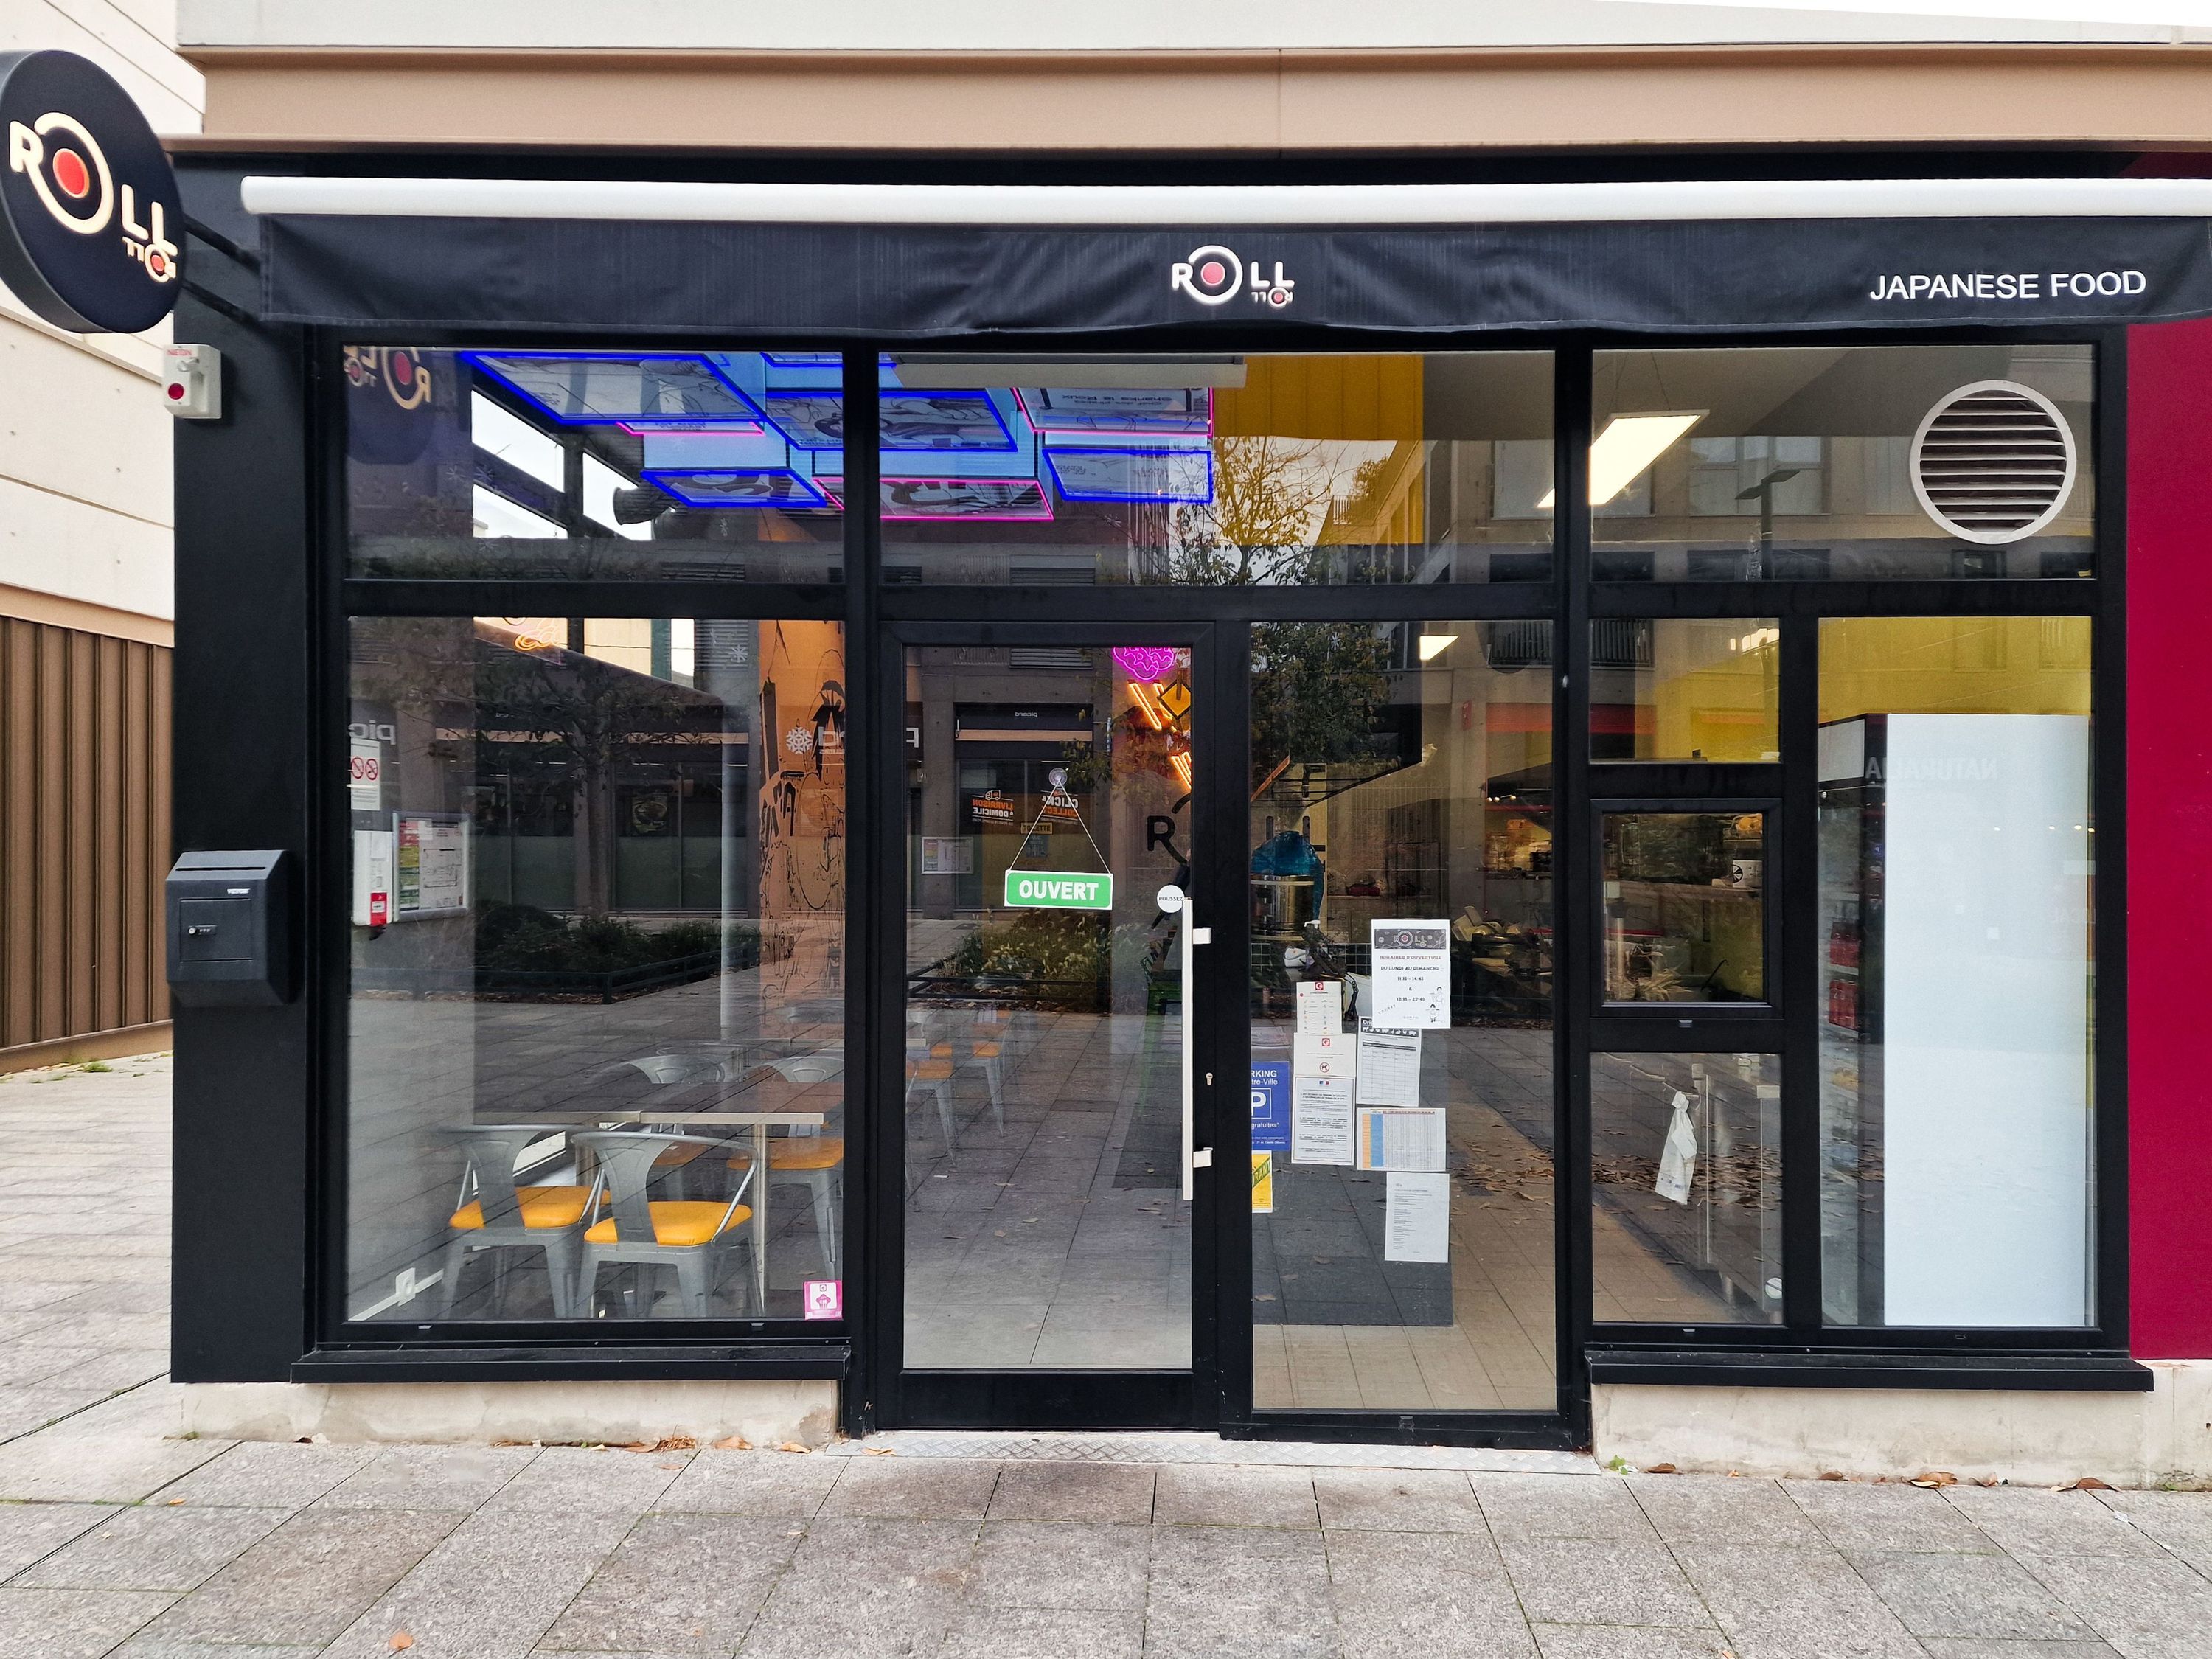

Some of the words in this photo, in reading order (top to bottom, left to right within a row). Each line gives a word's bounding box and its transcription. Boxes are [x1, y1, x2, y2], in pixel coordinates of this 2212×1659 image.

[10, 111, 178, 256] ROLL
[1172, 245, 1295, 306] ROLL
[1870, 274, 2040, 301] JAPANESE
[2051, 271, 2146, 297] FOOD
[1019, 880, 1099, 900] OUVERT
